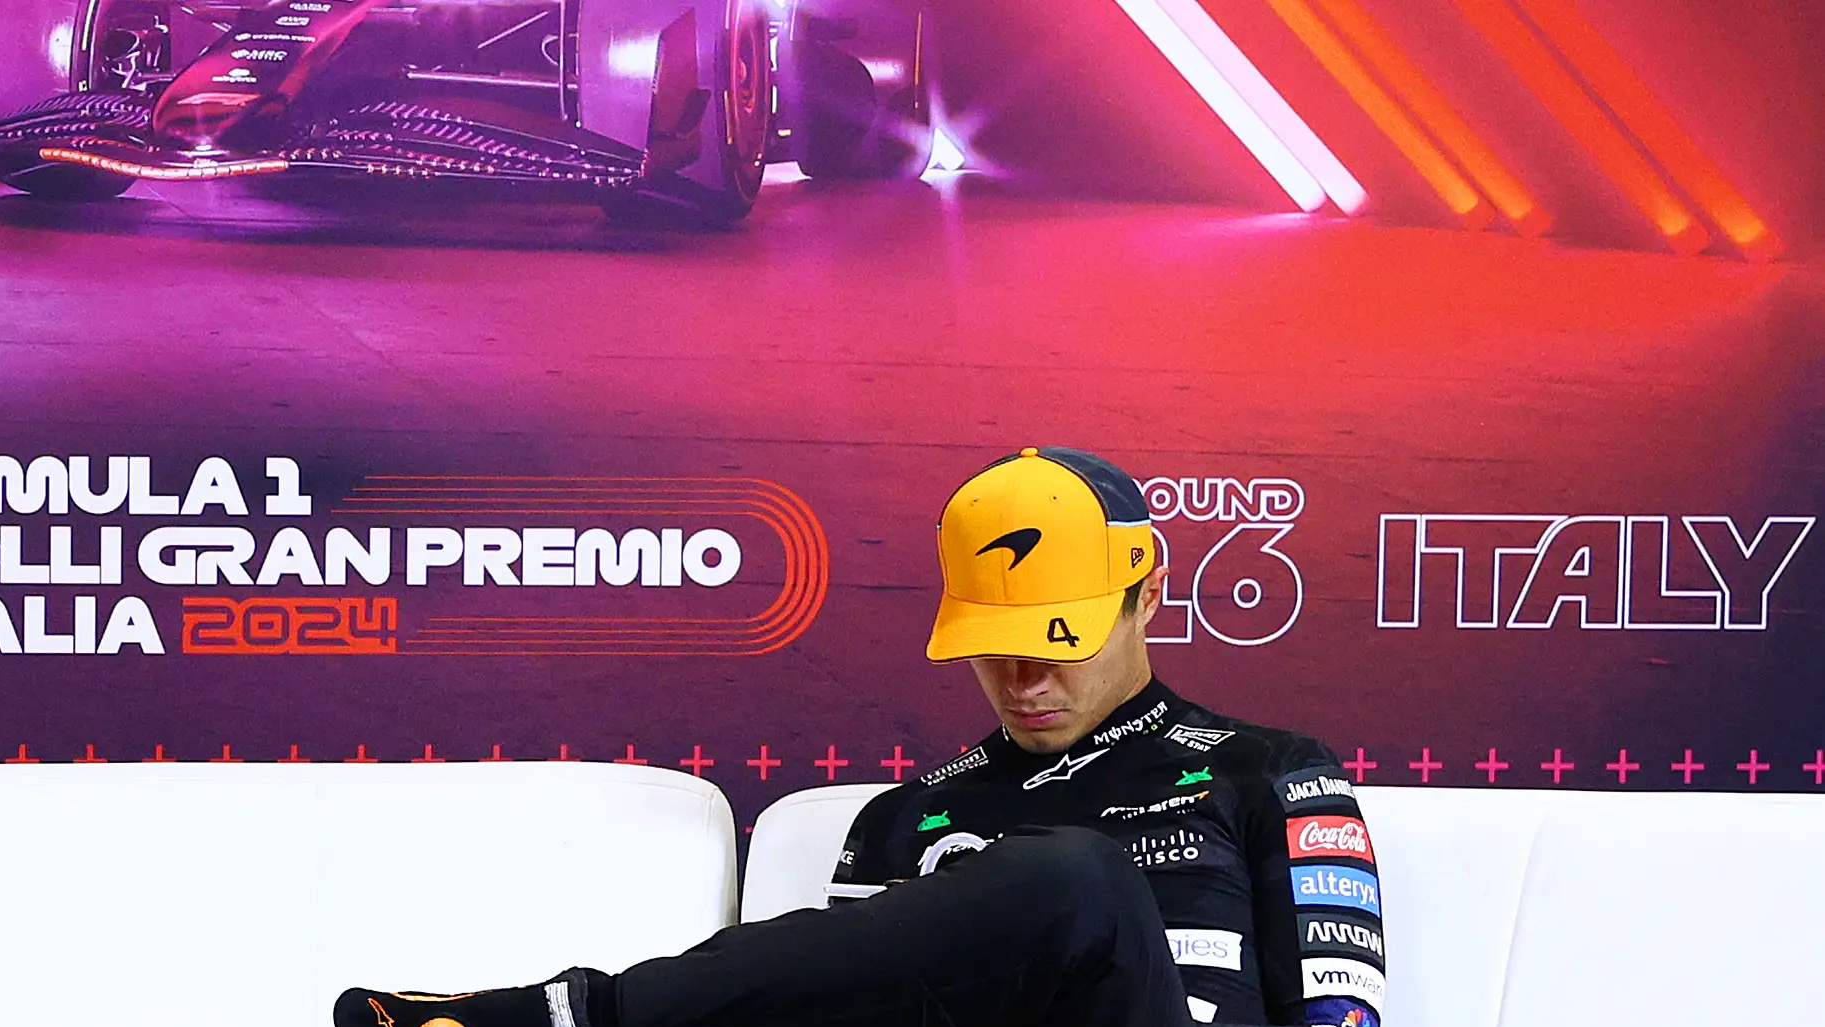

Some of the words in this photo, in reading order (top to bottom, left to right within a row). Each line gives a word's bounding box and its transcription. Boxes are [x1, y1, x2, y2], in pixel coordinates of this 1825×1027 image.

[263, 455, 312, 514] 1
[1132, 477, 1305, 521] OUND
[138, 527, 391, 587] GRAN
[406, 528, 742, 588] PREMIO
[1377, 514, 1816, 631] ITALY
[182, 598, 397, 655] 2024
[1047, 617, 1080, 648] 4
[1286, 782, 1322, 802] JACK
[1133, 847, 1199, 868] CISCO
[1301, 870, 1377, 905] alteryx
[1312, 970, 1383, 997] vmwar
